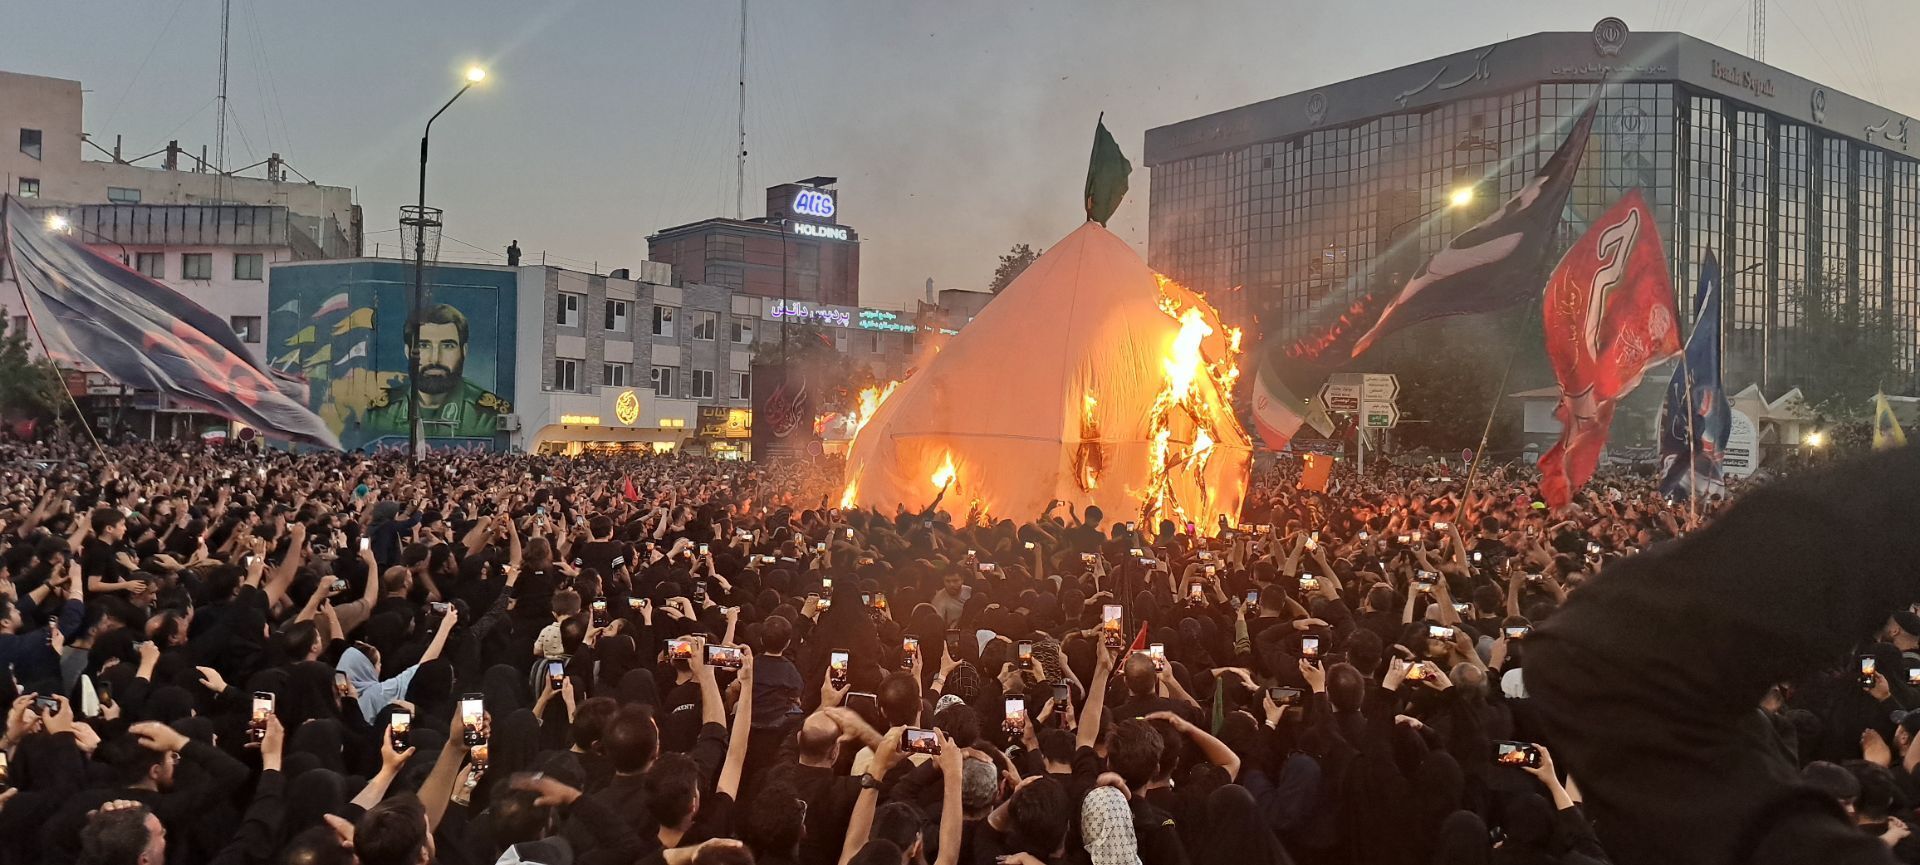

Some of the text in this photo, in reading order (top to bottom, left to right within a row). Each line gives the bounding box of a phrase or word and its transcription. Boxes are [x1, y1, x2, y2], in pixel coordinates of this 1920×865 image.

[1712, 59, 1776, 97] Bank Sepah
[795, 191, 834, 216] Alis
[794, 223, 848, 241] HOLDING
[771, 299, 809, 318] دانش
[703, 408, 727, 420] کباب
